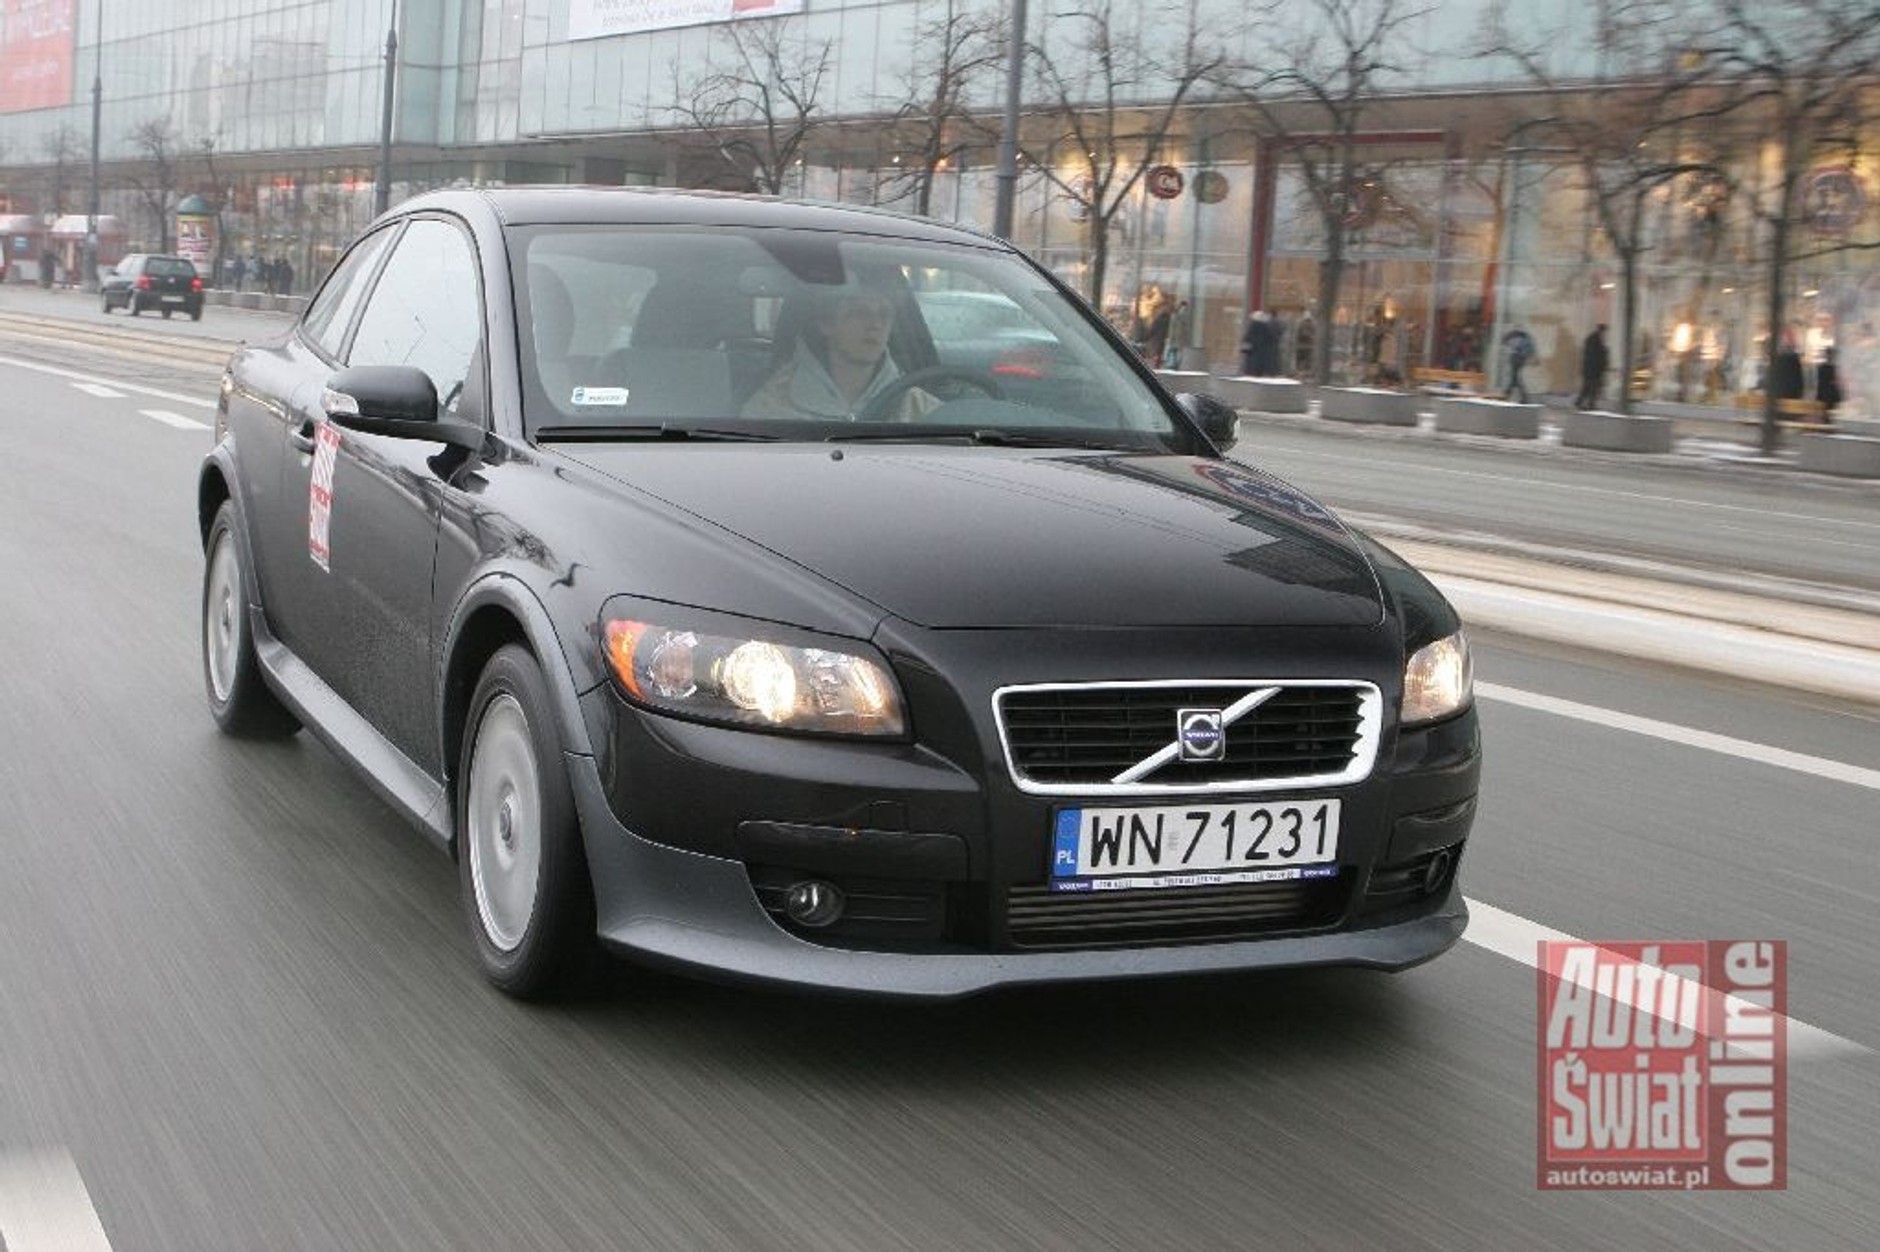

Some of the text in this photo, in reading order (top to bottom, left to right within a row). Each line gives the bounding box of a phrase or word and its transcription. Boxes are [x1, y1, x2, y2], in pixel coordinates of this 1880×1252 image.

[1090, 804, 1329, 868] WN 71231
[1057, 850, 1076, 865] PL
